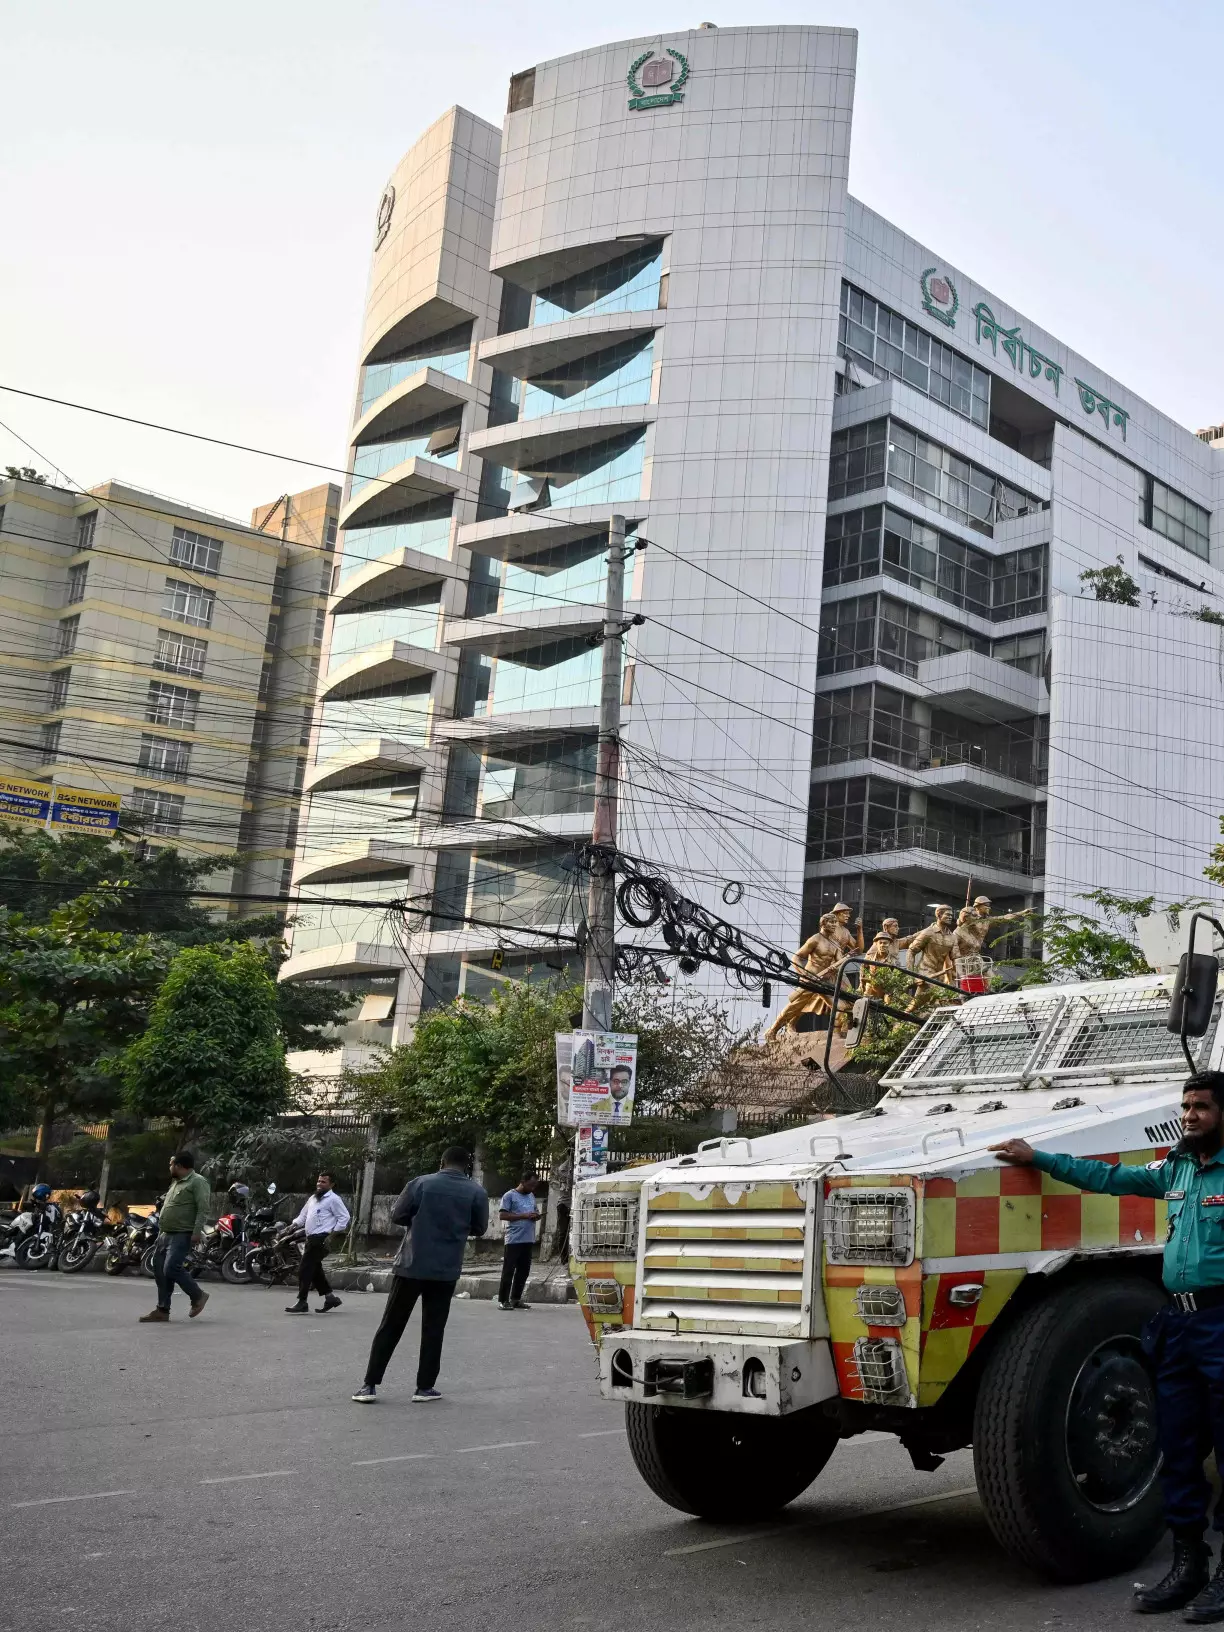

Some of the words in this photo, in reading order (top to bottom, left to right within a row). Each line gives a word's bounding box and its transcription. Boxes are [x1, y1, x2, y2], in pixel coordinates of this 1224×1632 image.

[972, 302, 1064, 398] নির্বাচন
[1074, 377, 1130, 442] ভবন
[7, 784, 50, 798] NETWORK
[77, 796, 118, 809] NETWORK
